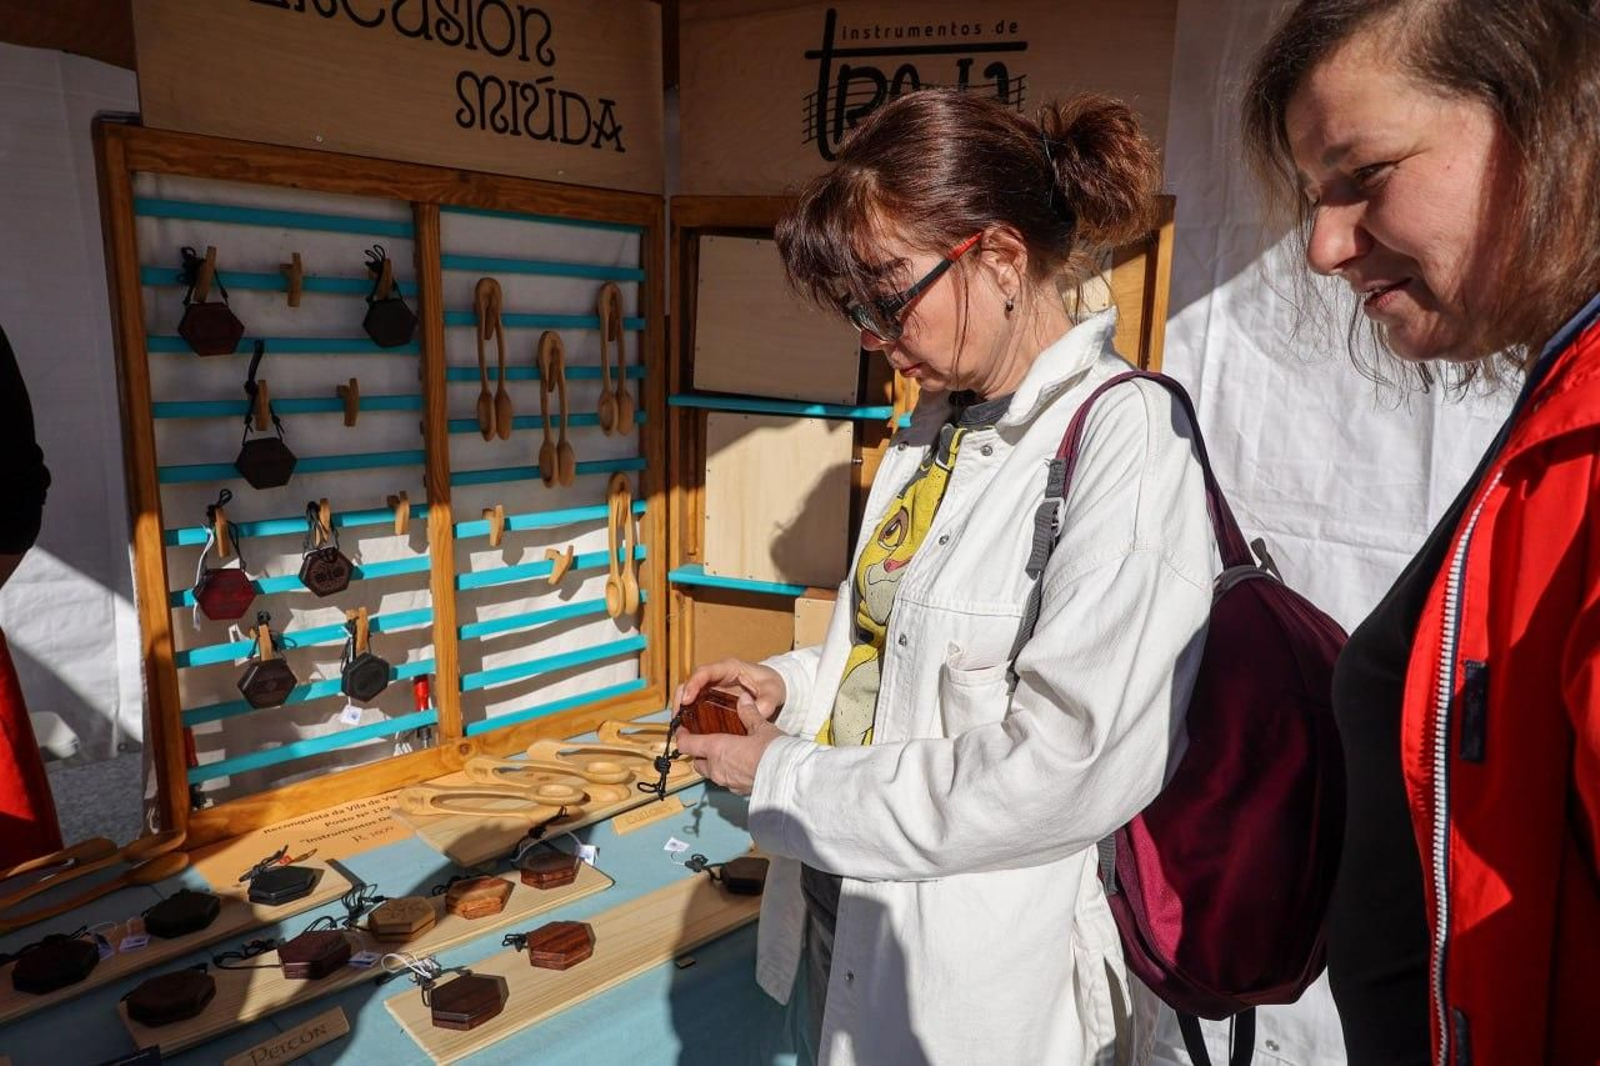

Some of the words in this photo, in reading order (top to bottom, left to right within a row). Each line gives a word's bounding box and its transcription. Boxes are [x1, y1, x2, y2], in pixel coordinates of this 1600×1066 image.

[842, 21, 983, 40] instrumentos
[995, 20, 1019, 34] de
[455, 70, 626, 153] MIÚDA
